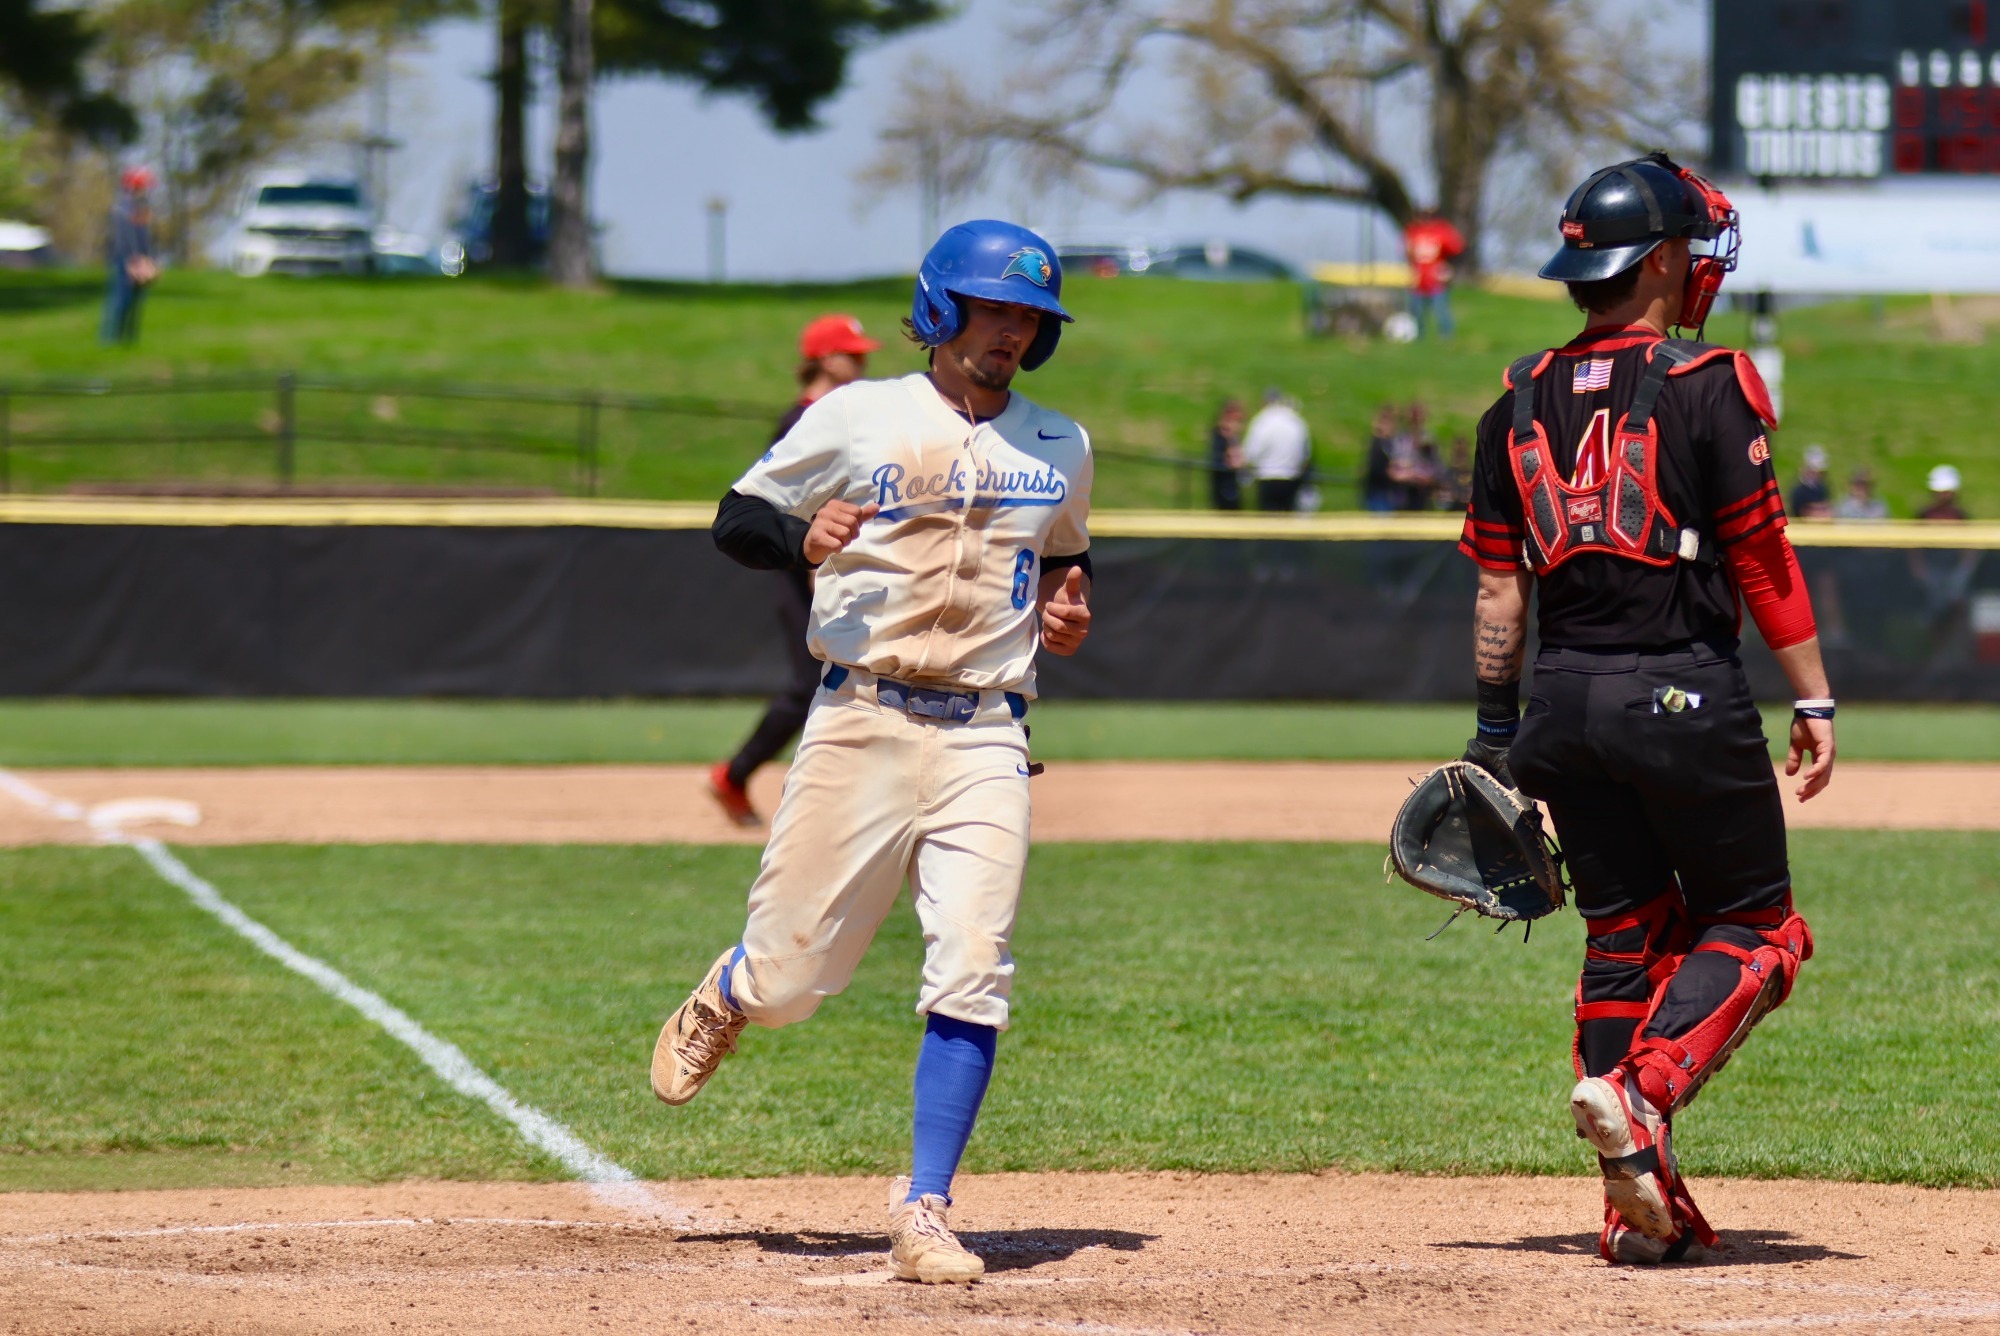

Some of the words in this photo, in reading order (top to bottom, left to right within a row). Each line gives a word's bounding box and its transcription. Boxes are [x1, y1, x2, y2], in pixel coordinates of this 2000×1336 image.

[1737, 74, 1890, 129] GUESTS
[872, 459, 1067, 507] Rockhurst
[1011, 549, 1034, 611] 6
